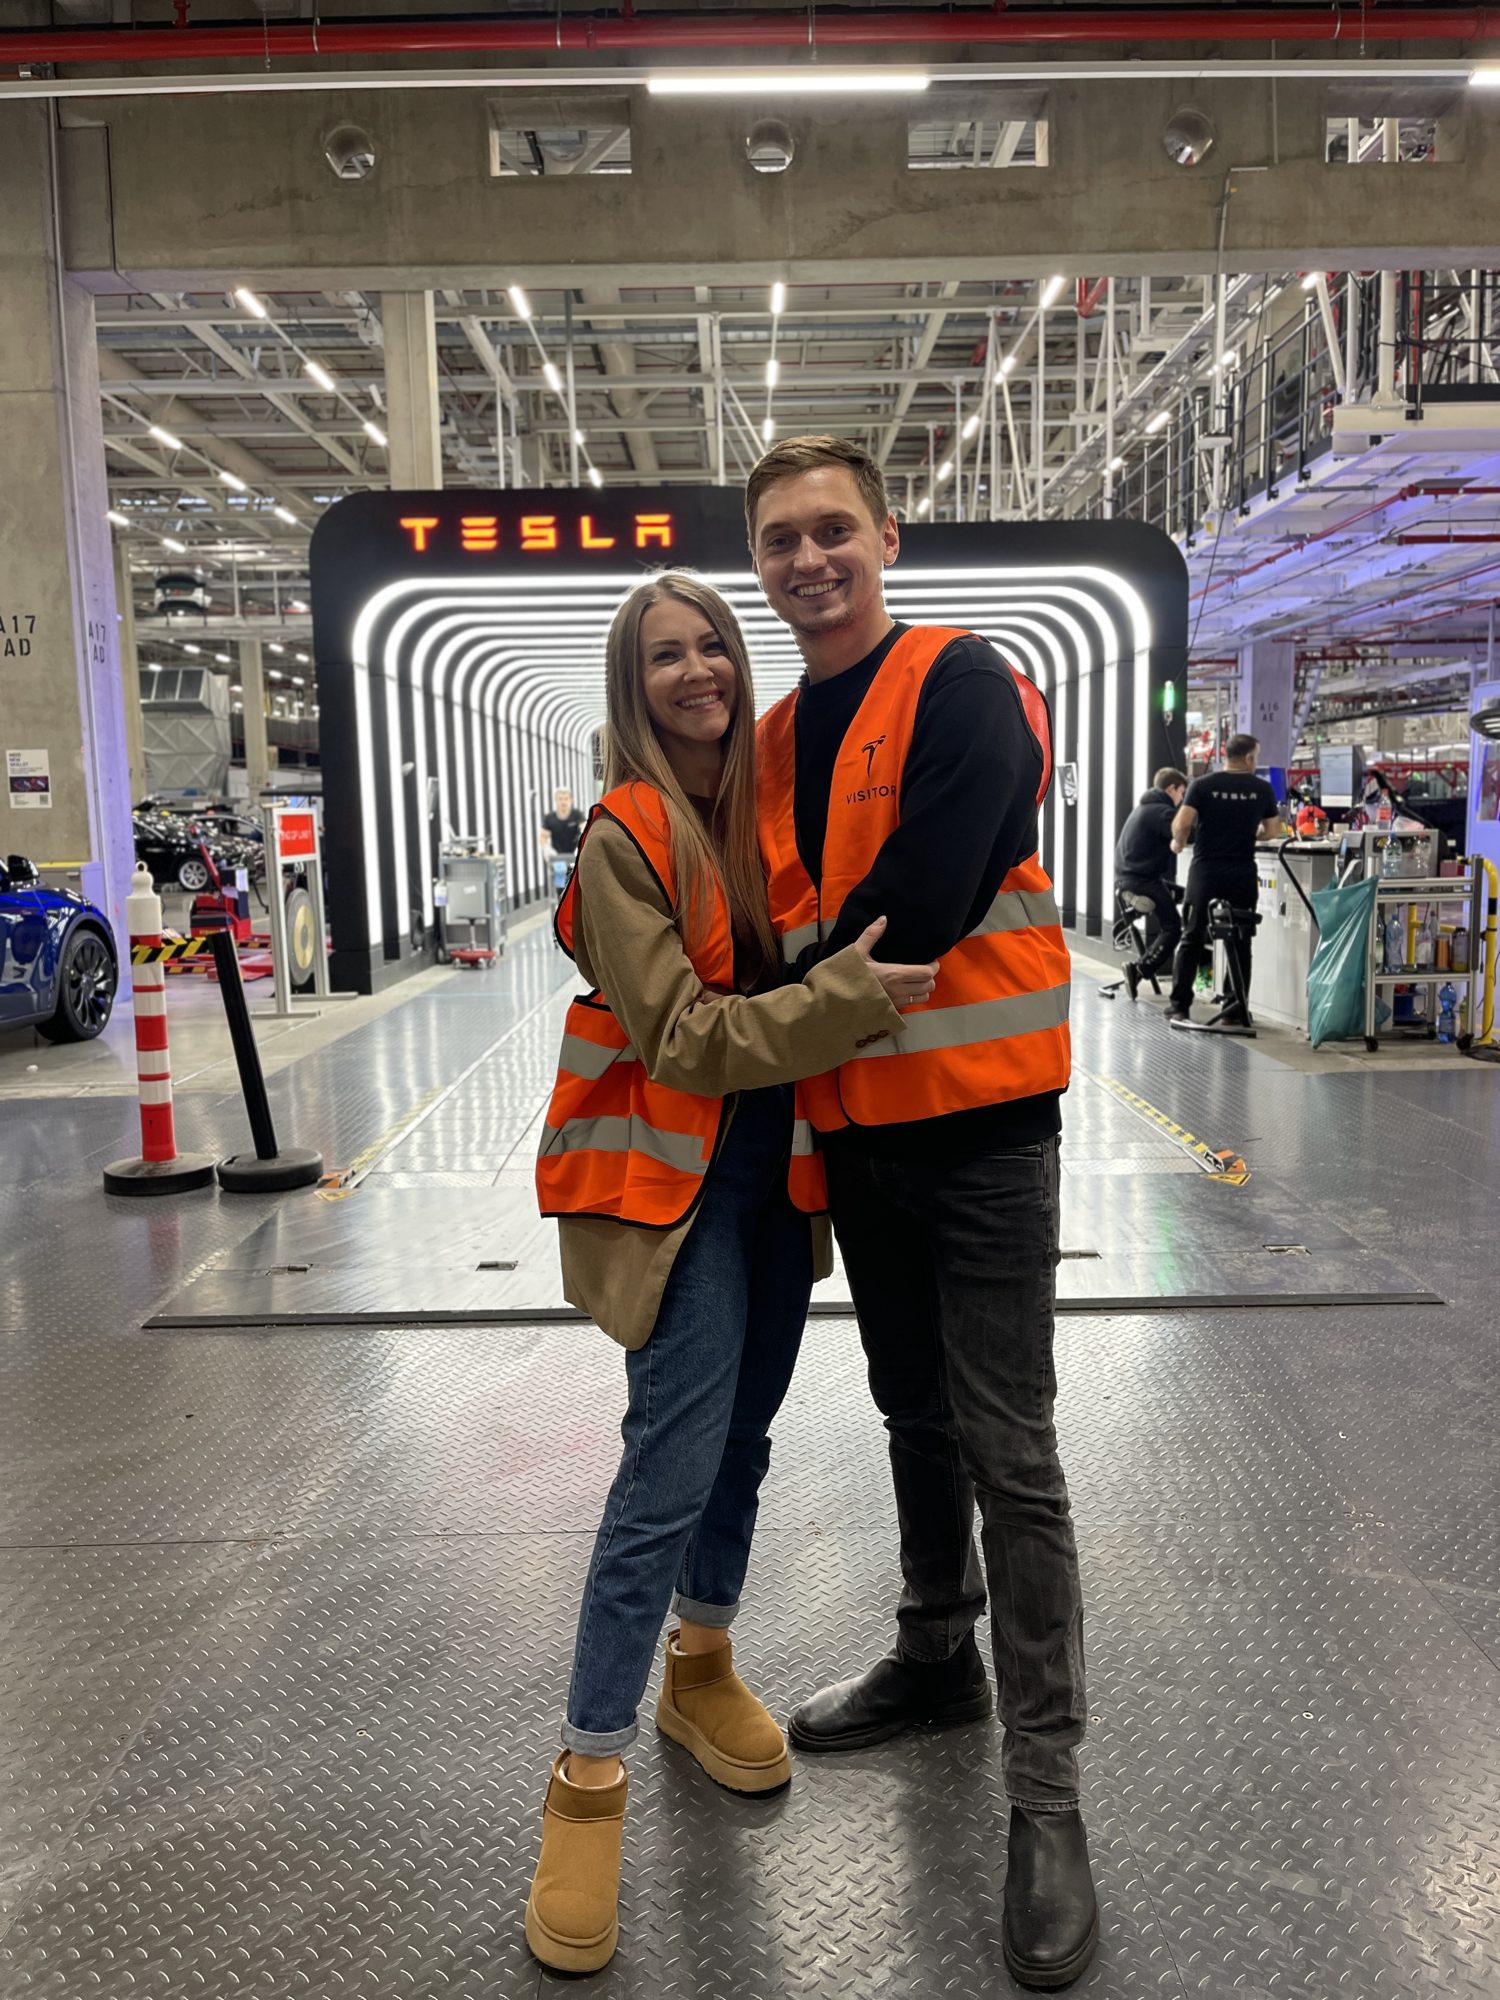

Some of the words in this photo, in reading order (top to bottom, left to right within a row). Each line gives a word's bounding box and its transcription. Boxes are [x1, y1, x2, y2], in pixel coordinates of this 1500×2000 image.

[400, 514, 671, 551] TESLA
[88, 621, 106, 643] A17
[4, 638, 31, 657] AD
[93, 644, 105, 664] AD
[846, 784, 897, 805] VISITOR
[1211, 791, 1257, 800] TESLA
